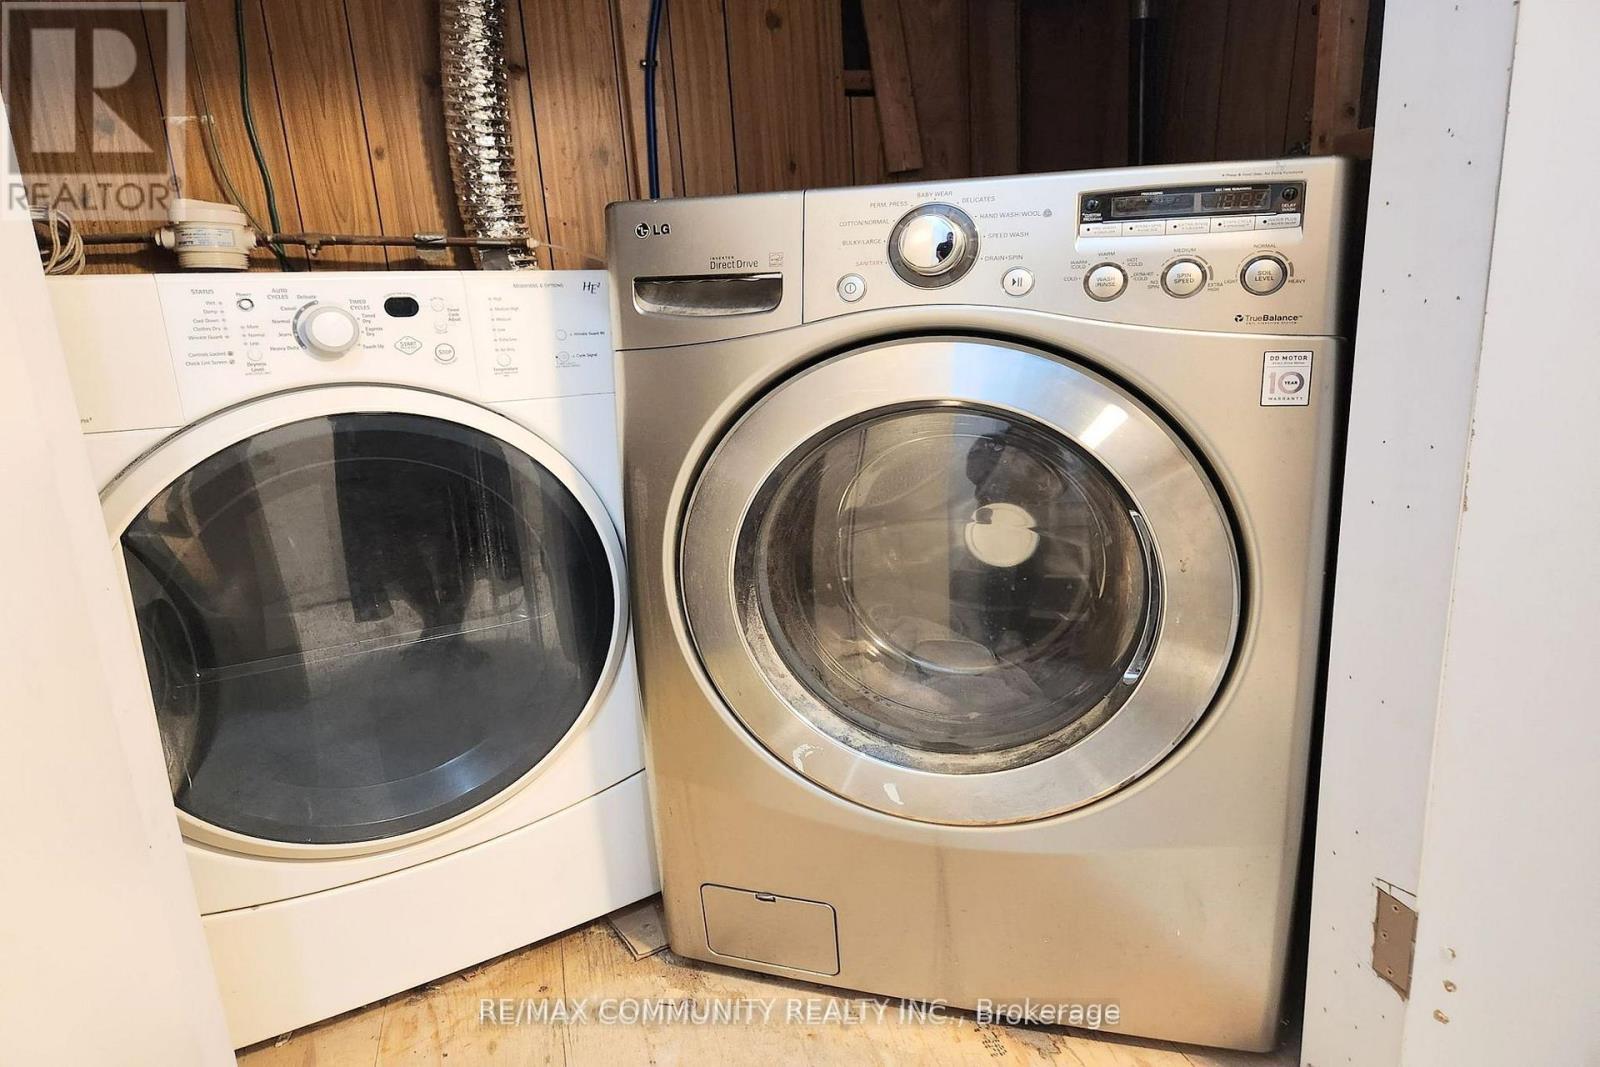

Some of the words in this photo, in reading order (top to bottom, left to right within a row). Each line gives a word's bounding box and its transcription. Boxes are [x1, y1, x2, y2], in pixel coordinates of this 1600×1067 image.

[653, 224, 671, 235] LG
[710, 261, 735, 270] Direct
[737, 260, 759, 269] Drive
